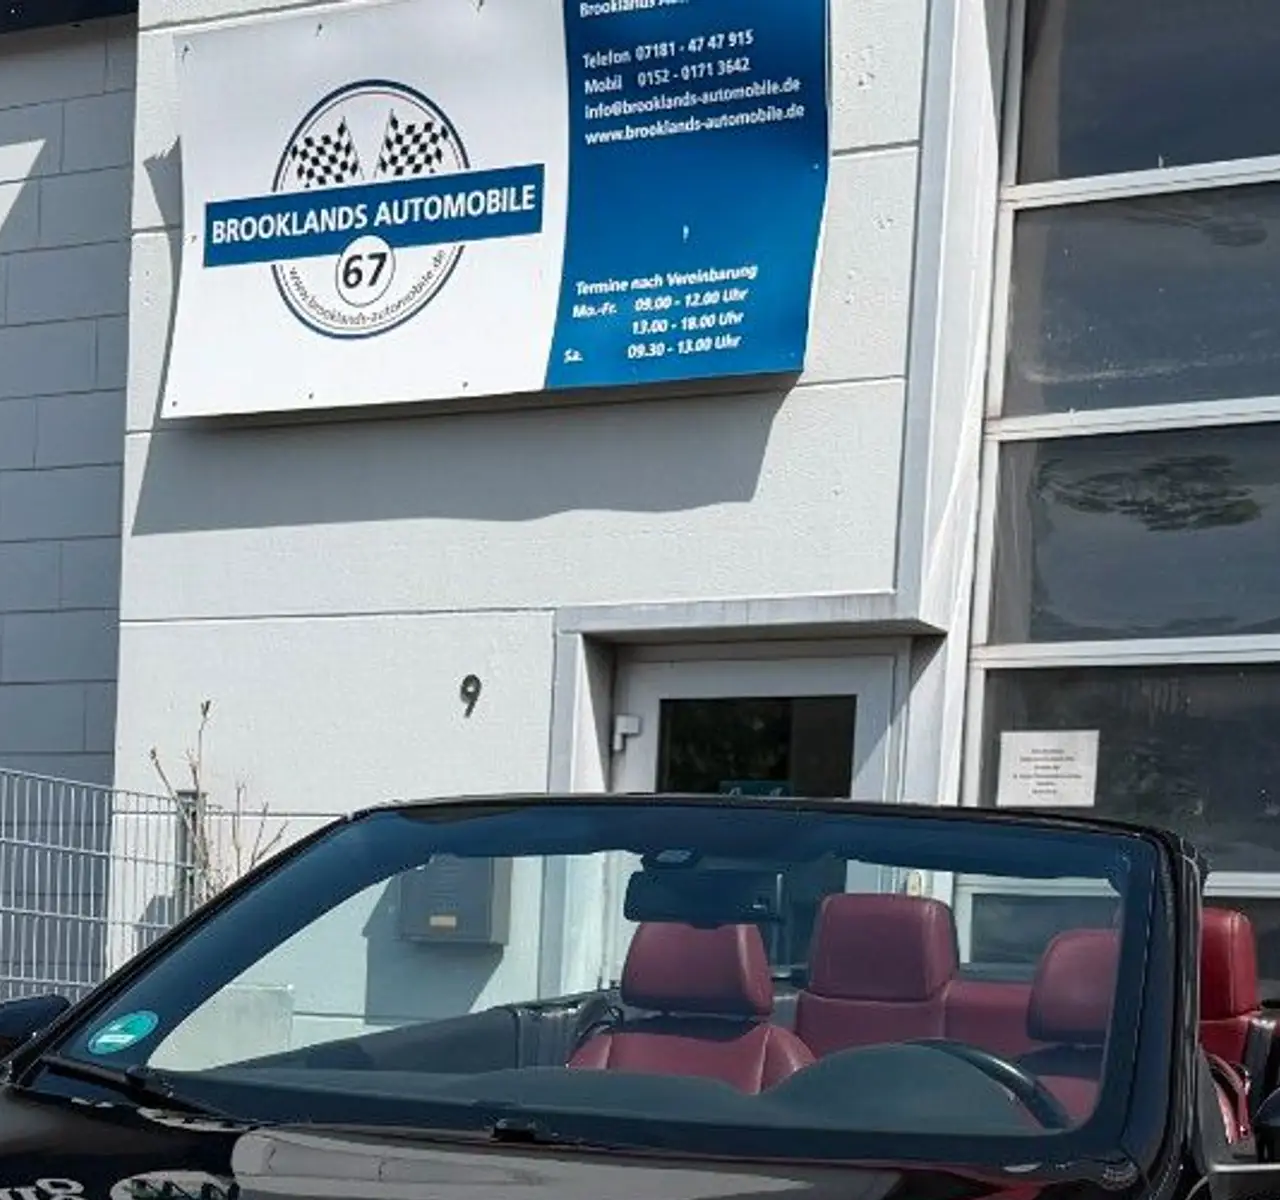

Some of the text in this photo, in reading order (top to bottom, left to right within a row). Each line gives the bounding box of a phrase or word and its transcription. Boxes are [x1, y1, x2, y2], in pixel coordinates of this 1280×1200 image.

[582, 50, 632, 68] Telefon
[635, 42, 676, 61] 07181
[687, 37, 705, 53] 47
[707, 34, 725, 50] 47
[727, 29, 755, 46] 915
[584, 75, 623, 95] Mobil
[637, 68, 670, 87] 0152
[681, 62, 713, 80] 0171
[585, 77, 801, 120] info@brooklands-automobile.de
[585, 103, 805, 145] www.brooklands-automobile.de
[211, 184, 536, 244] BROOKLANDS AUTOMOBILE
[342, 252, 387, 289] 67
[576, 264, 758, 296] Termine nach Vereinbarung
[685, 291, 720, 308] 12.00
[722, 287, 749, 301] Uhr
[719, 310, 744, 325] Uhr
[628, 343, 665, 359] 09.30
[715, 334, 742, 350] Uhr
[460, 674, 482, 718] 9
